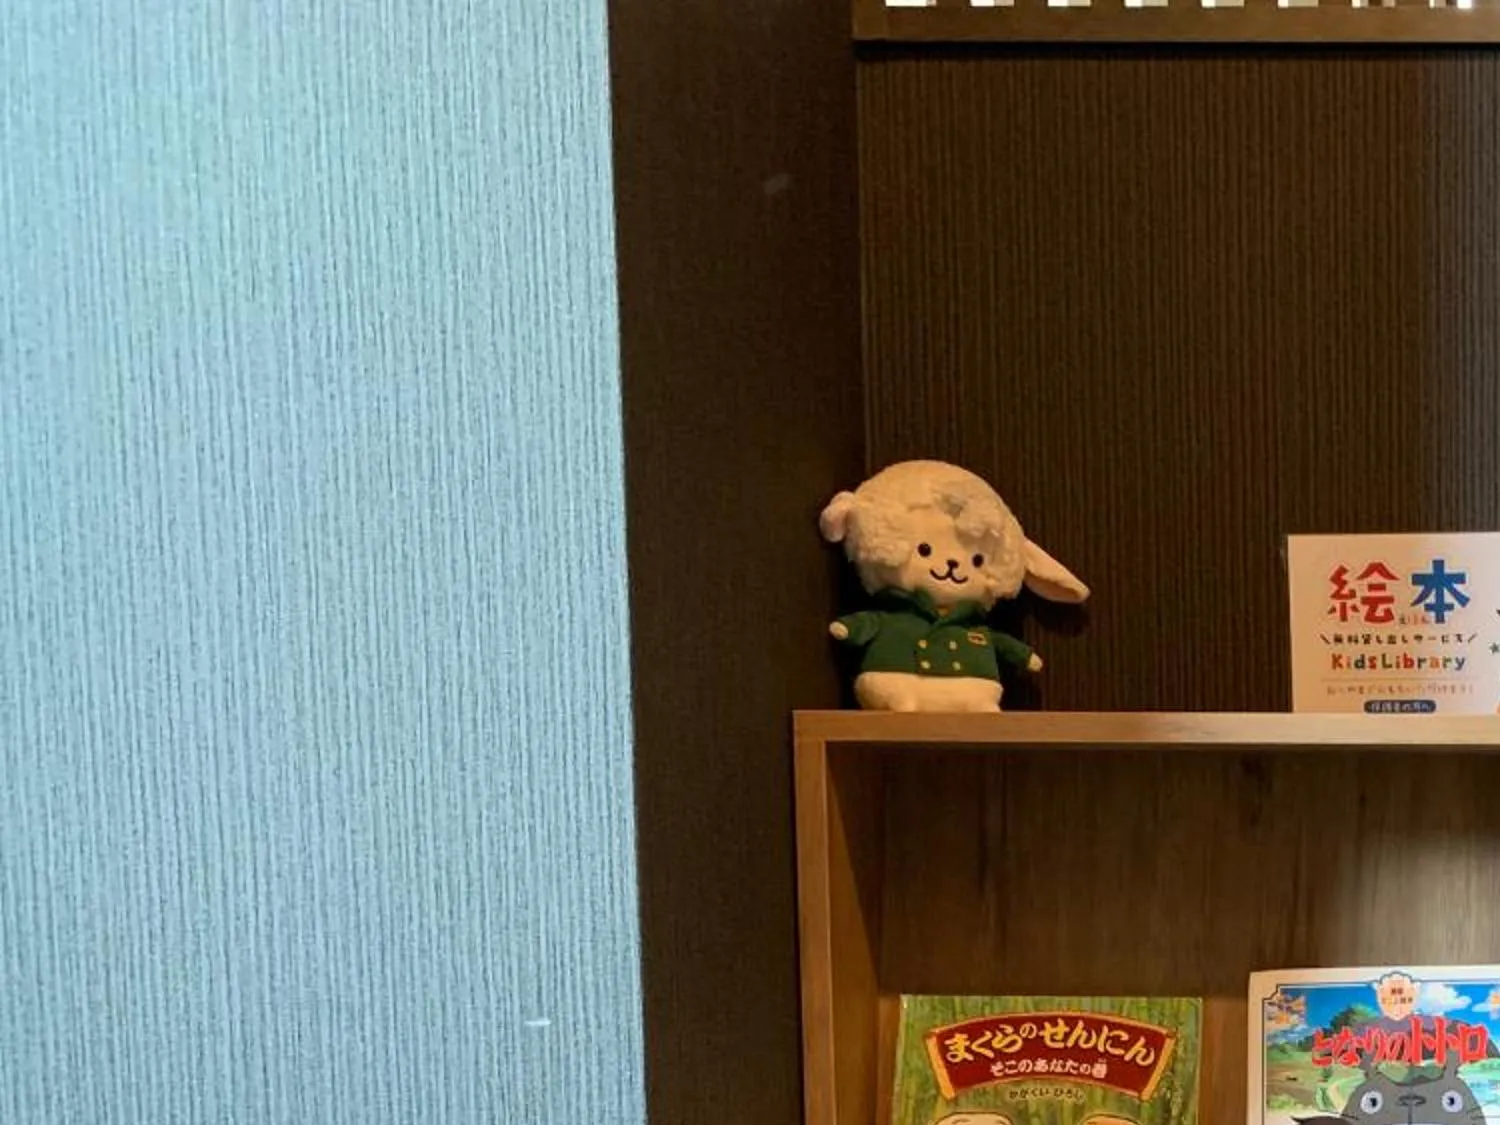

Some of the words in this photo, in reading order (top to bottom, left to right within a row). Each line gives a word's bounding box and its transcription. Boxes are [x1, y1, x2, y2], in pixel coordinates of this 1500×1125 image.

[1327, 559, 1471, 624] 絵本
[945, 1018, 1155, 1067] まくらのせんにん
[1311, 1016, 1489, 1067] となりのトトロ
